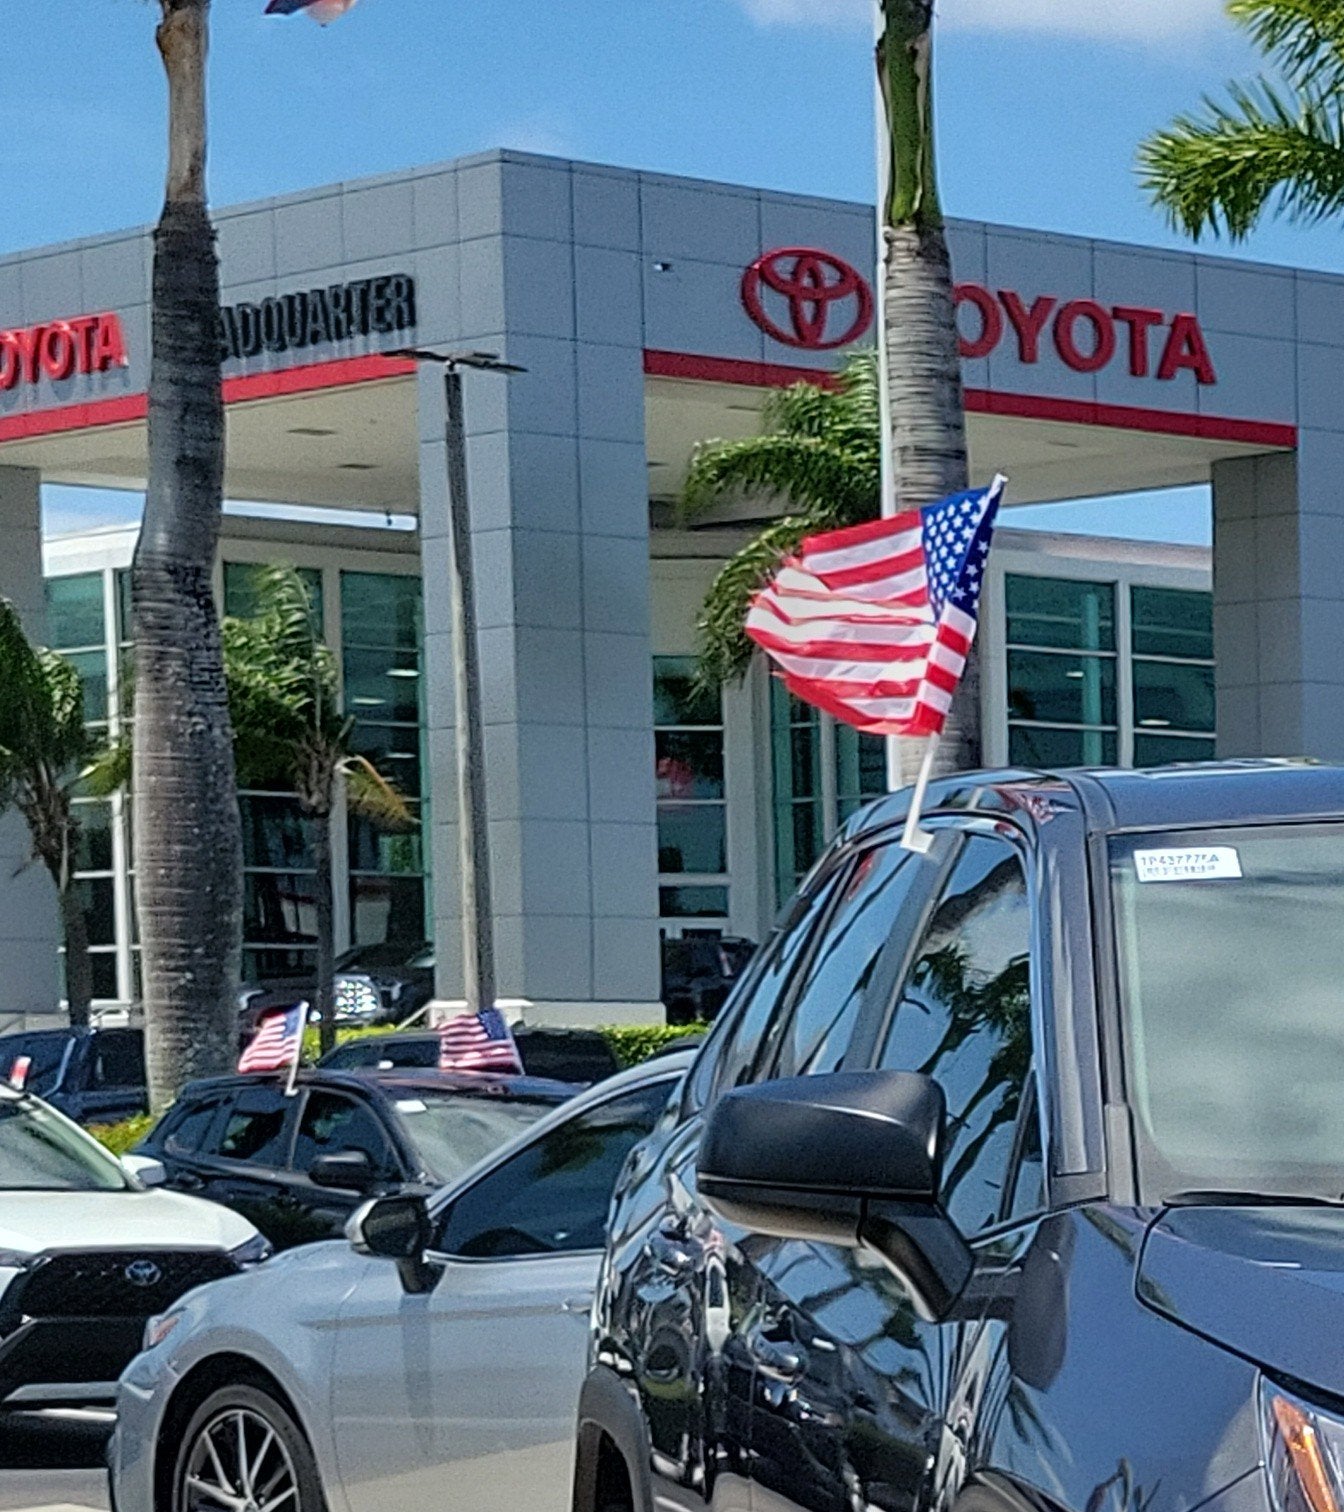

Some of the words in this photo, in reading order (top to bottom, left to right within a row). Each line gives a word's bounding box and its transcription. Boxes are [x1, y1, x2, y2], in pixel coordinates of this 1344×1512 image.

[0, 311, 129, 390] OYOTA
[219, 273, 416, 360] ADQUARTER
[952, 282, 1217, 385] OYOTA
